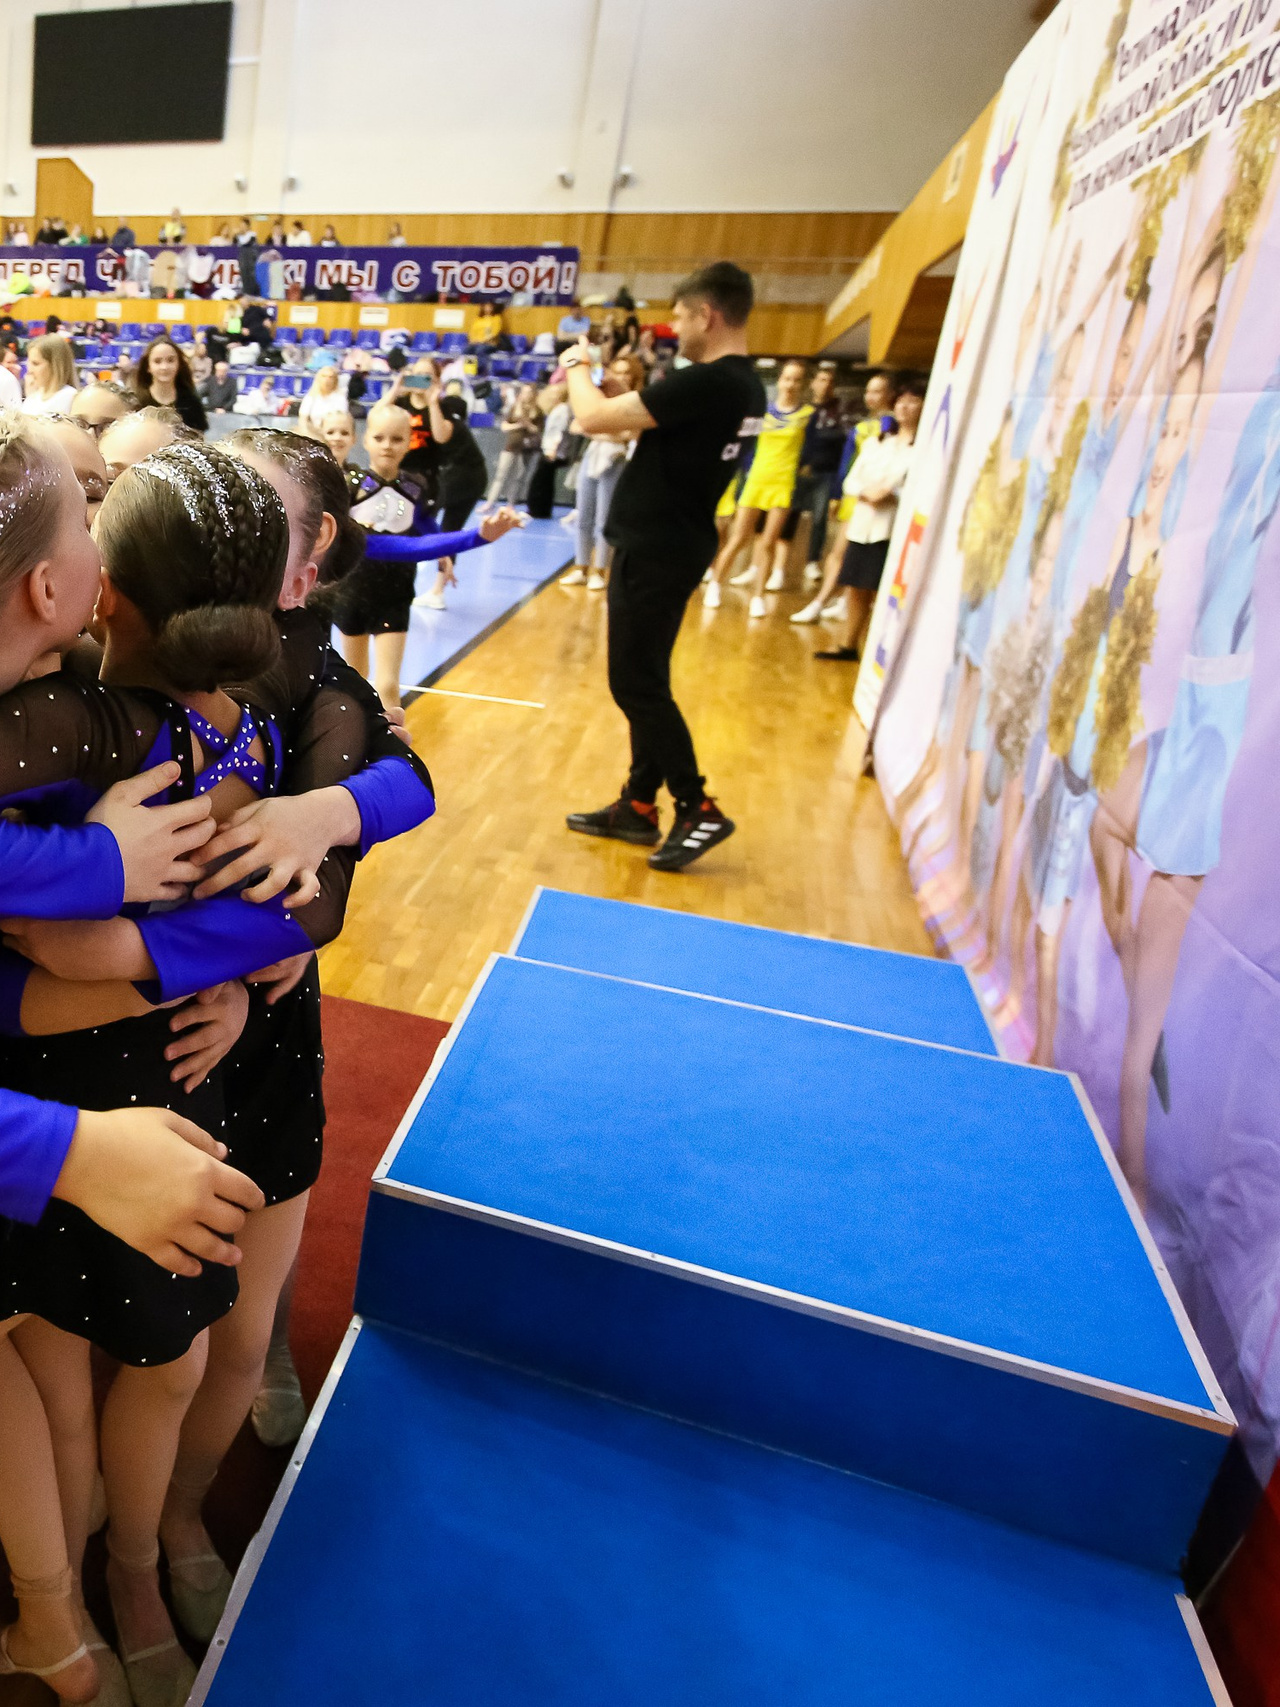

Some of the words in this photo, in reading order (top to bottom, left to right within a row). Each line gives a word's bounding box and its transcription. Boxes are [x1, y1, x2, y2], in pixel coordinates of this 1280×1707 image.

[315, 259, 379, 290] МЫ
[393, 260, 420, 292] С
[432, 255, 577, 294] ТОБОЙ!
